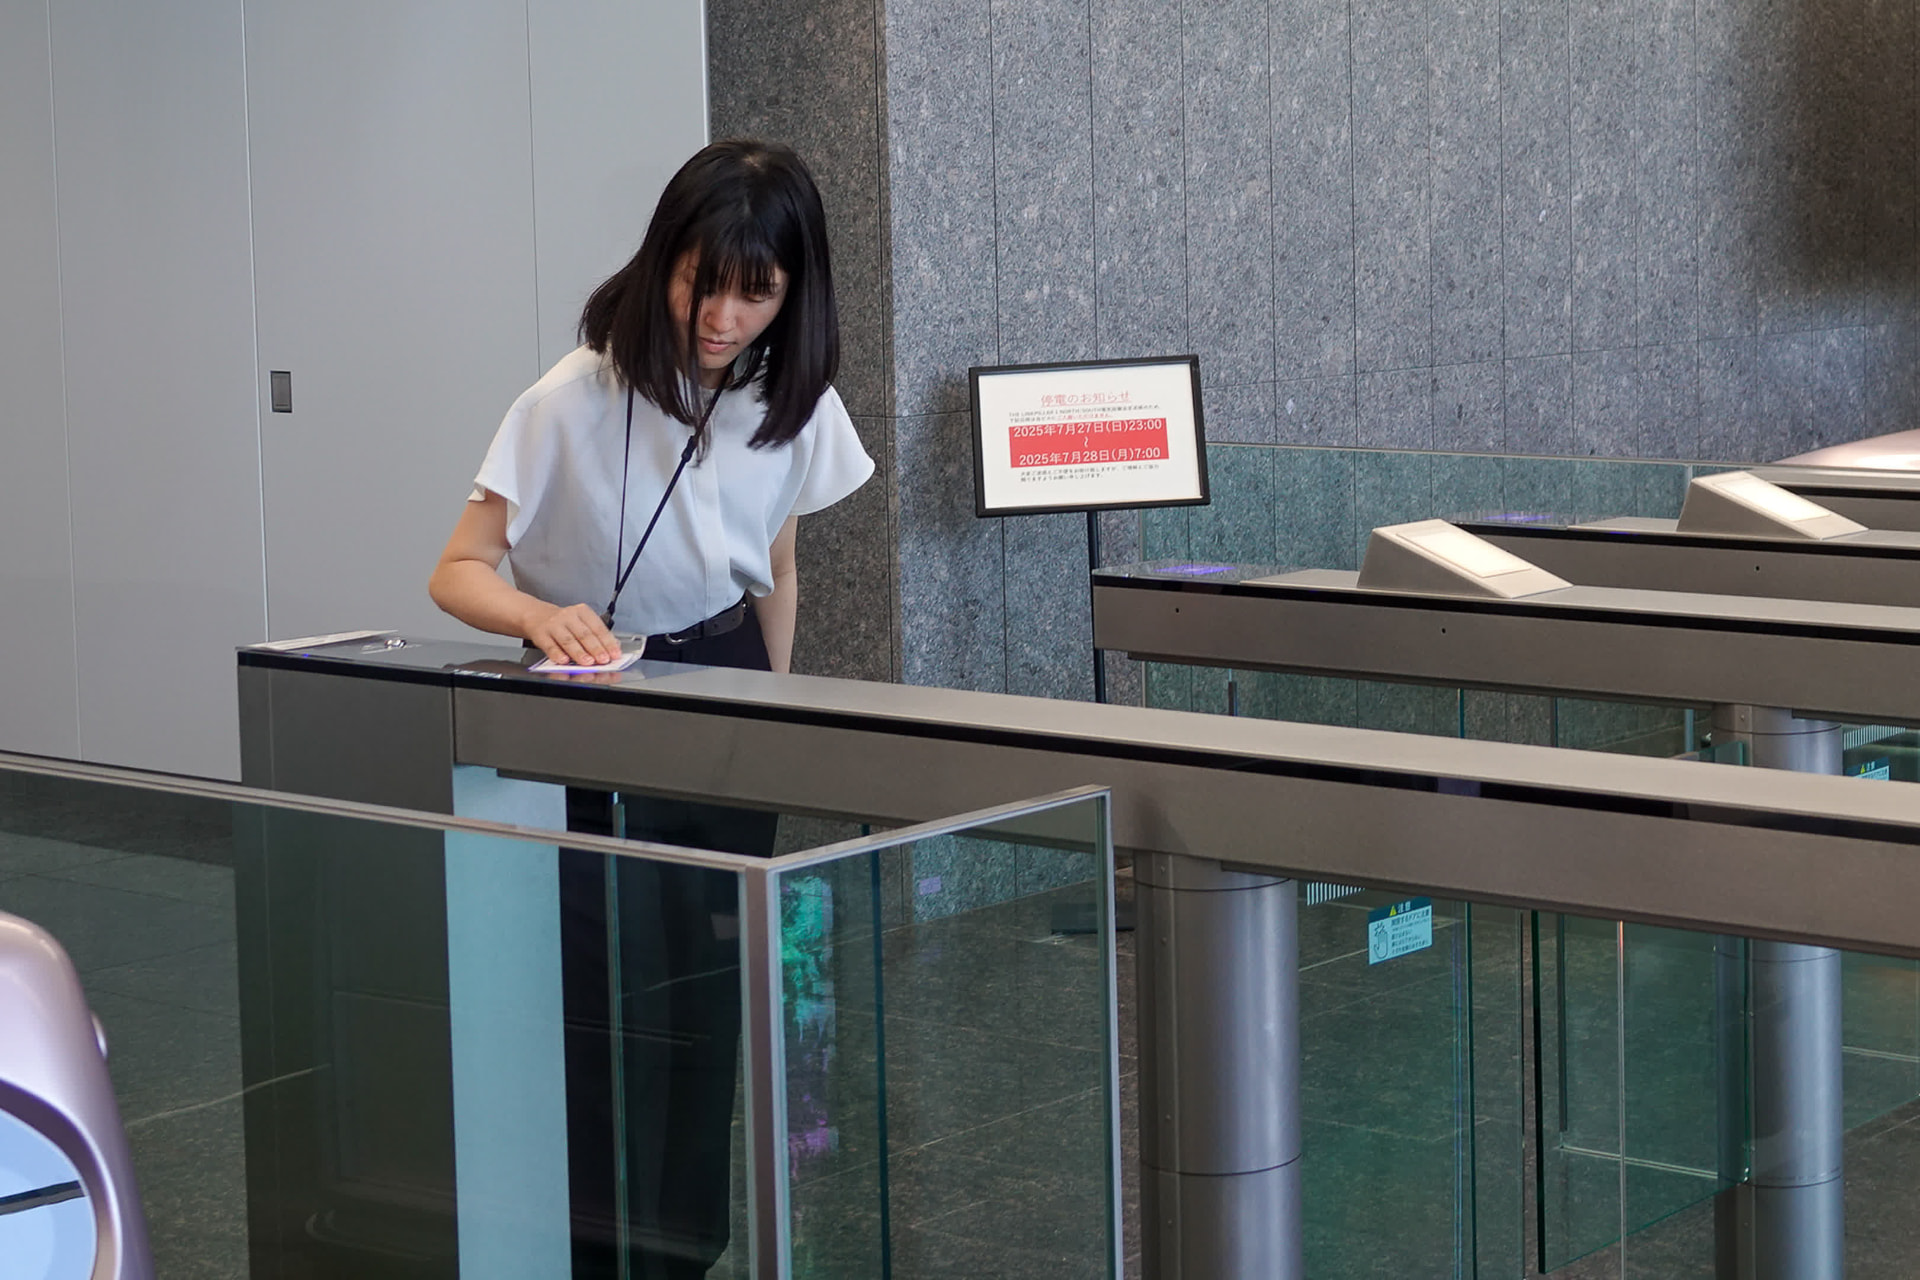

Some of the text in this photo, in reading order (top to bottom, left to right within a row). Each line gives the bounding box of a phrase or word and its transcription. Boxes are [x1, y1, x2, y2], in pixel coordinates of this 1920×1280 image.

[1041, 391, 1131, 407] 停電のお知らせ
[1014, 419, 1162, 437] 2025年7月27日(日)23:00
[1019, 447, 1161, 465] 2025年7月28日(月)7:00
